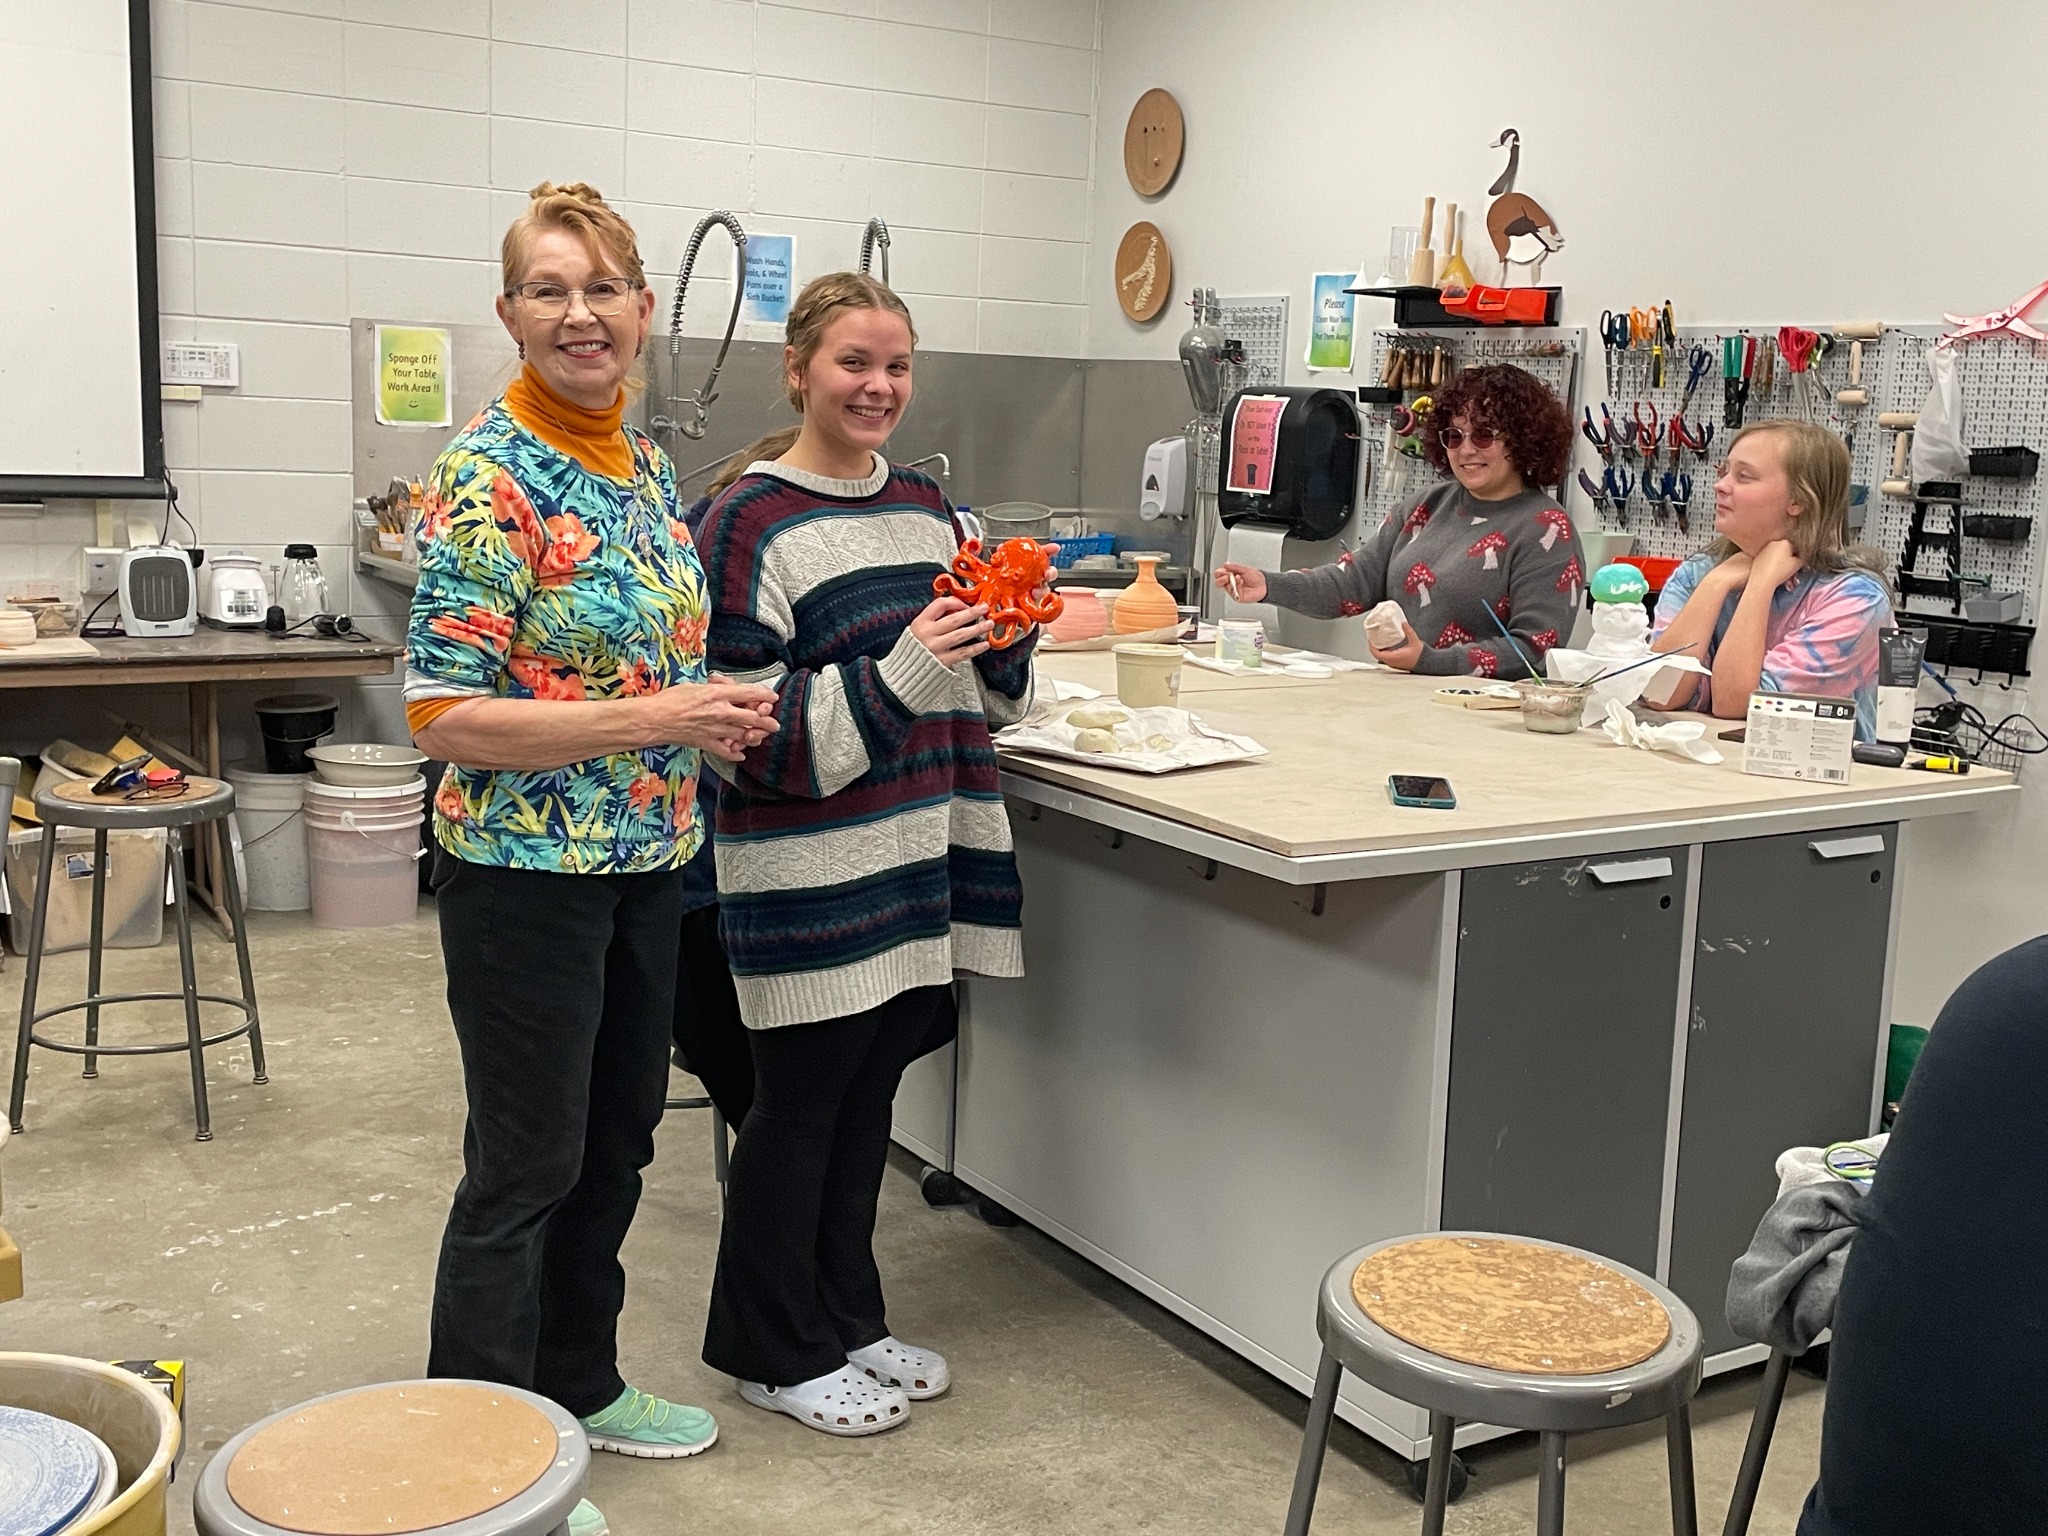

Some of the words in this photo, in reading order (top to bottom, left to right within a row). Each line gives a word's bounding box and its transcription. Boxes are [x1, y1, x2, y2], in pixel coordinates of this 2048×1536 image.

[1324, 298, 1345, 309] Please
[388, 353, 419, 366] Sponge
[421, 354, 437, 364] Off
[392, 368, 412, 377] Your
[414, 368, 437, 379] Table
[387, 382, 409, 392] Work
[411, 383, 431, 393] Area
